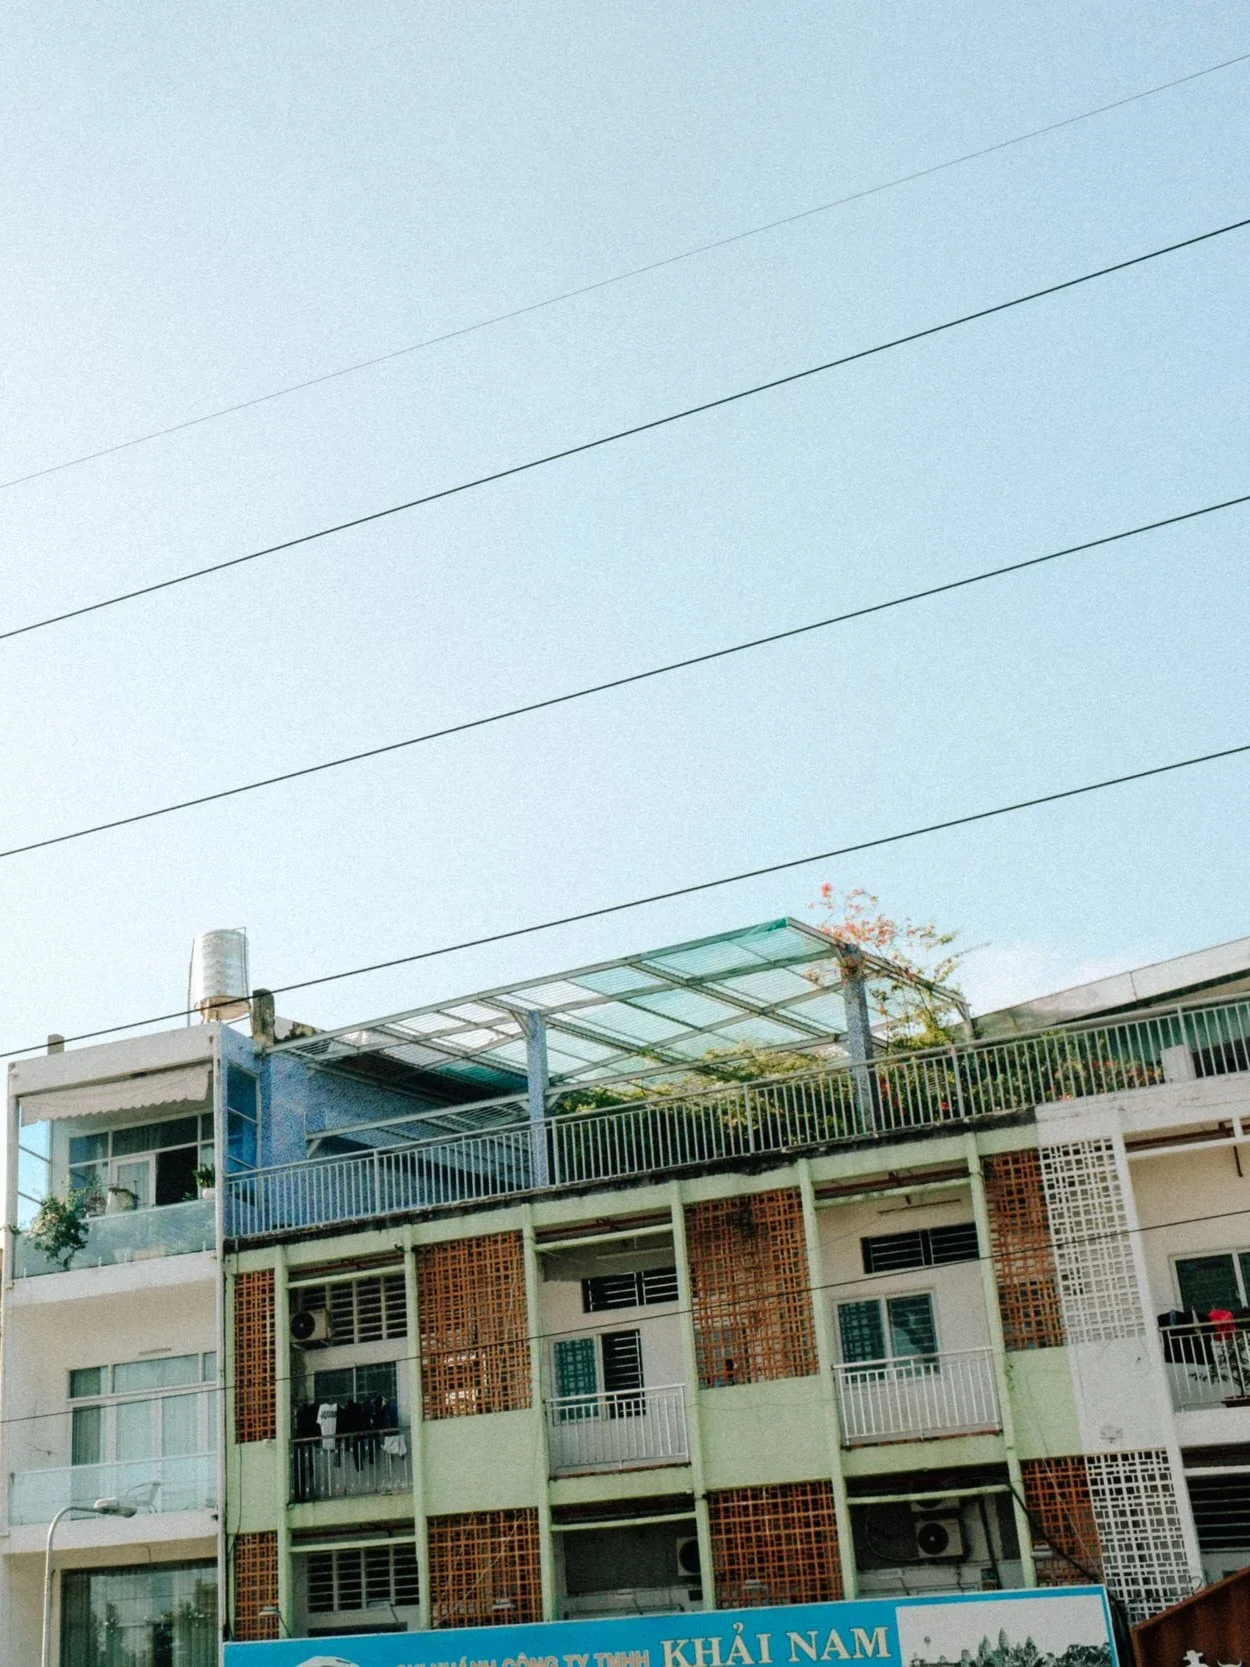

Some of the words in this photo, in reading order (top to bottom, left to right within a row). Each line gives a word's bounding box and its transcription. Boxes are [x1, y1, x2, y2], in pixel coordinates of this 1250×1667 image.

[562, 1653, 589, 1667] TY
[593, 1649, 649, 1667] TNHH
[659, 1621, 773, 1667] KHẢI
[786, 1626, 892, 1662] NAM
